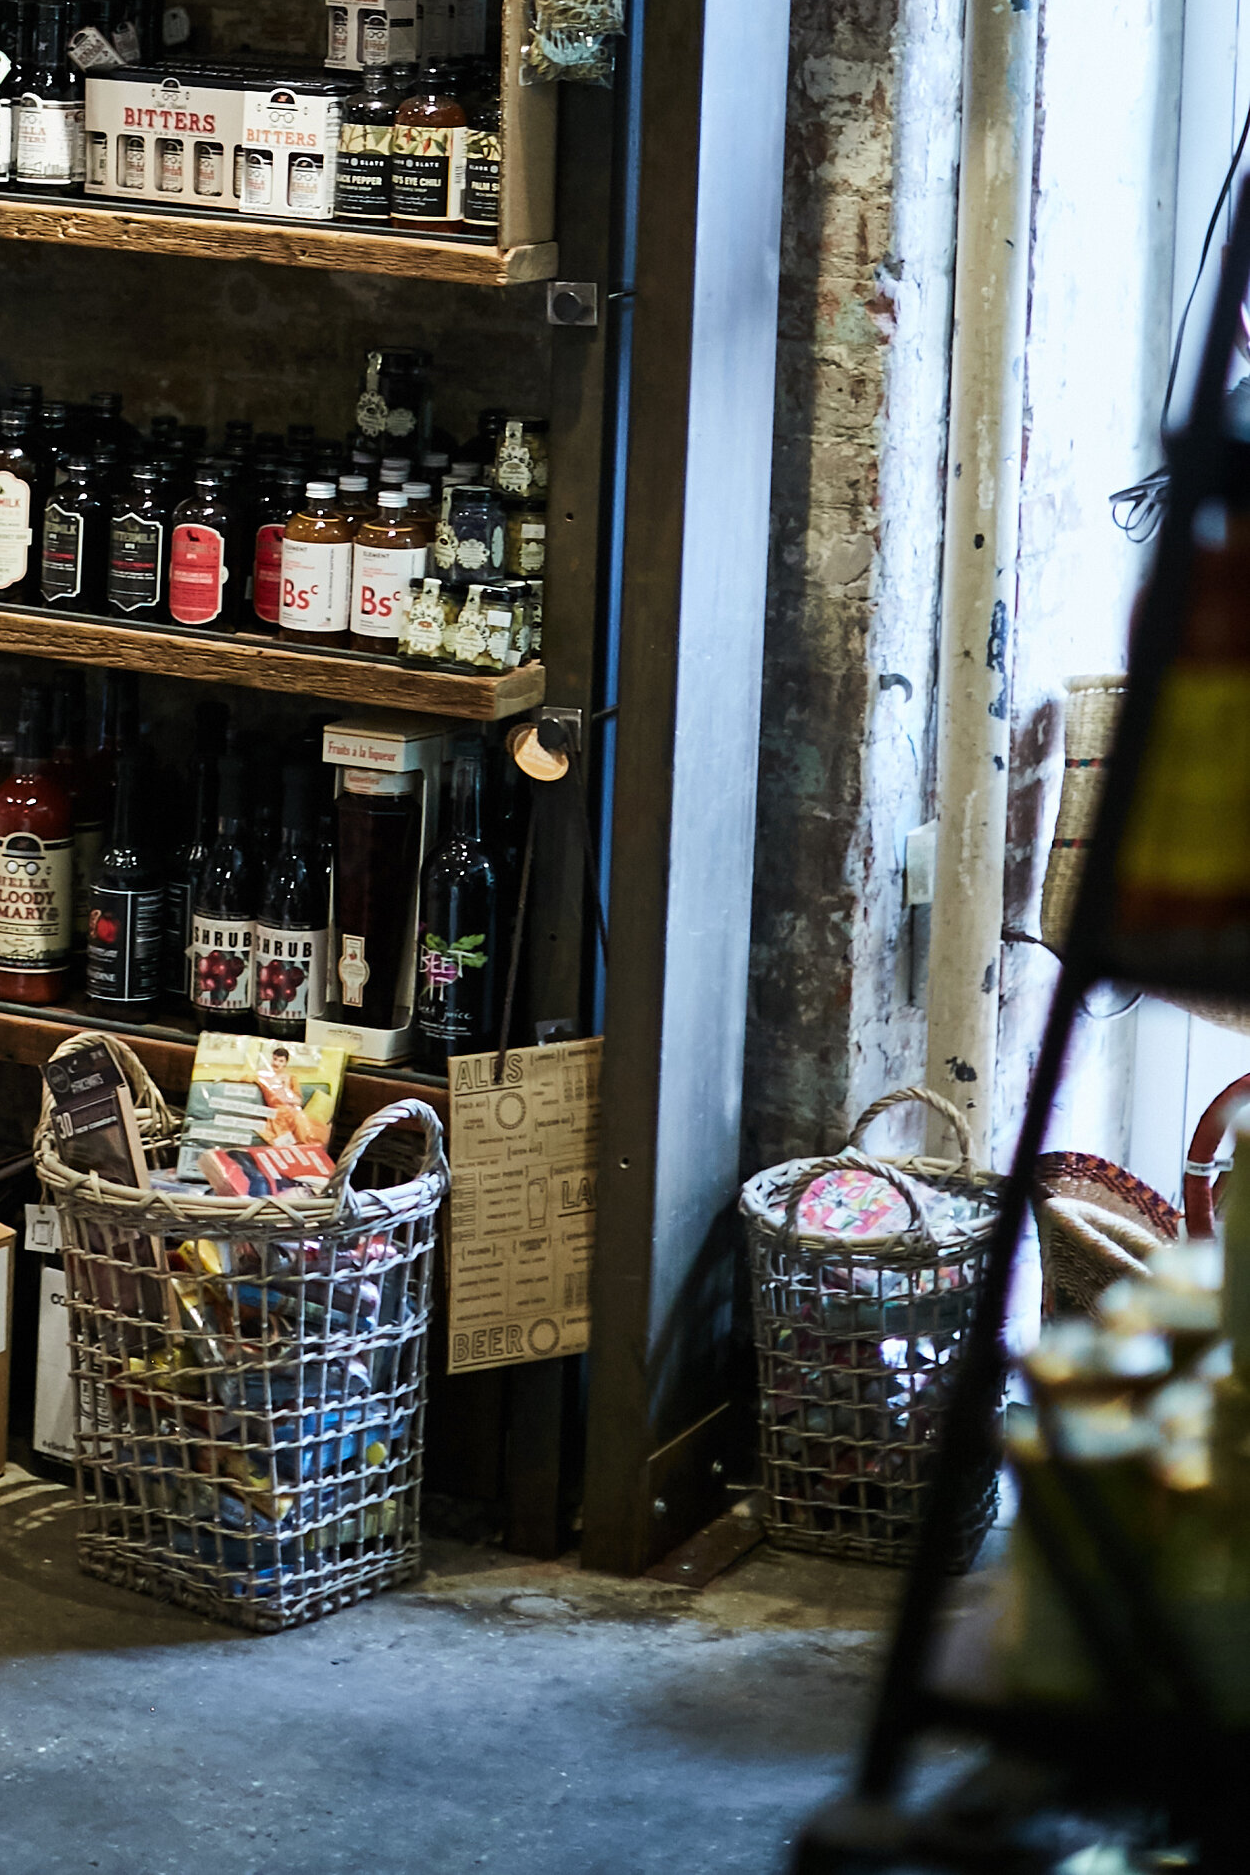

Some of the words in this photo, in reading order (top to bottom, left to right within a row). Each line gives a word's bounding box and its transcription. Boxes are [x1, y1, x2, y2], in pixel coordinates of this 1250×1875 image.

[123, 106, 216, 135] BITTERS
[245, 128, 318, 148] BITTERS
[351, 175, 383, 186] PEPPER
[404, 176, 419, 187] EYE
[419, 178, 442, 188] CHILI
[363, 550, 390, 558] ELEMENT
[327, 740, 350, 757] Fruits
[194, 926, 253, 948] SHRUB
[255, 934, 313, 959] SHRUB
[419, 943, 476, 979] BEET
[443, 1006, 475, 1022] juice
[56, 1111, 74, 1140] 3D
[452, 1324, 525, 1364] BEER
